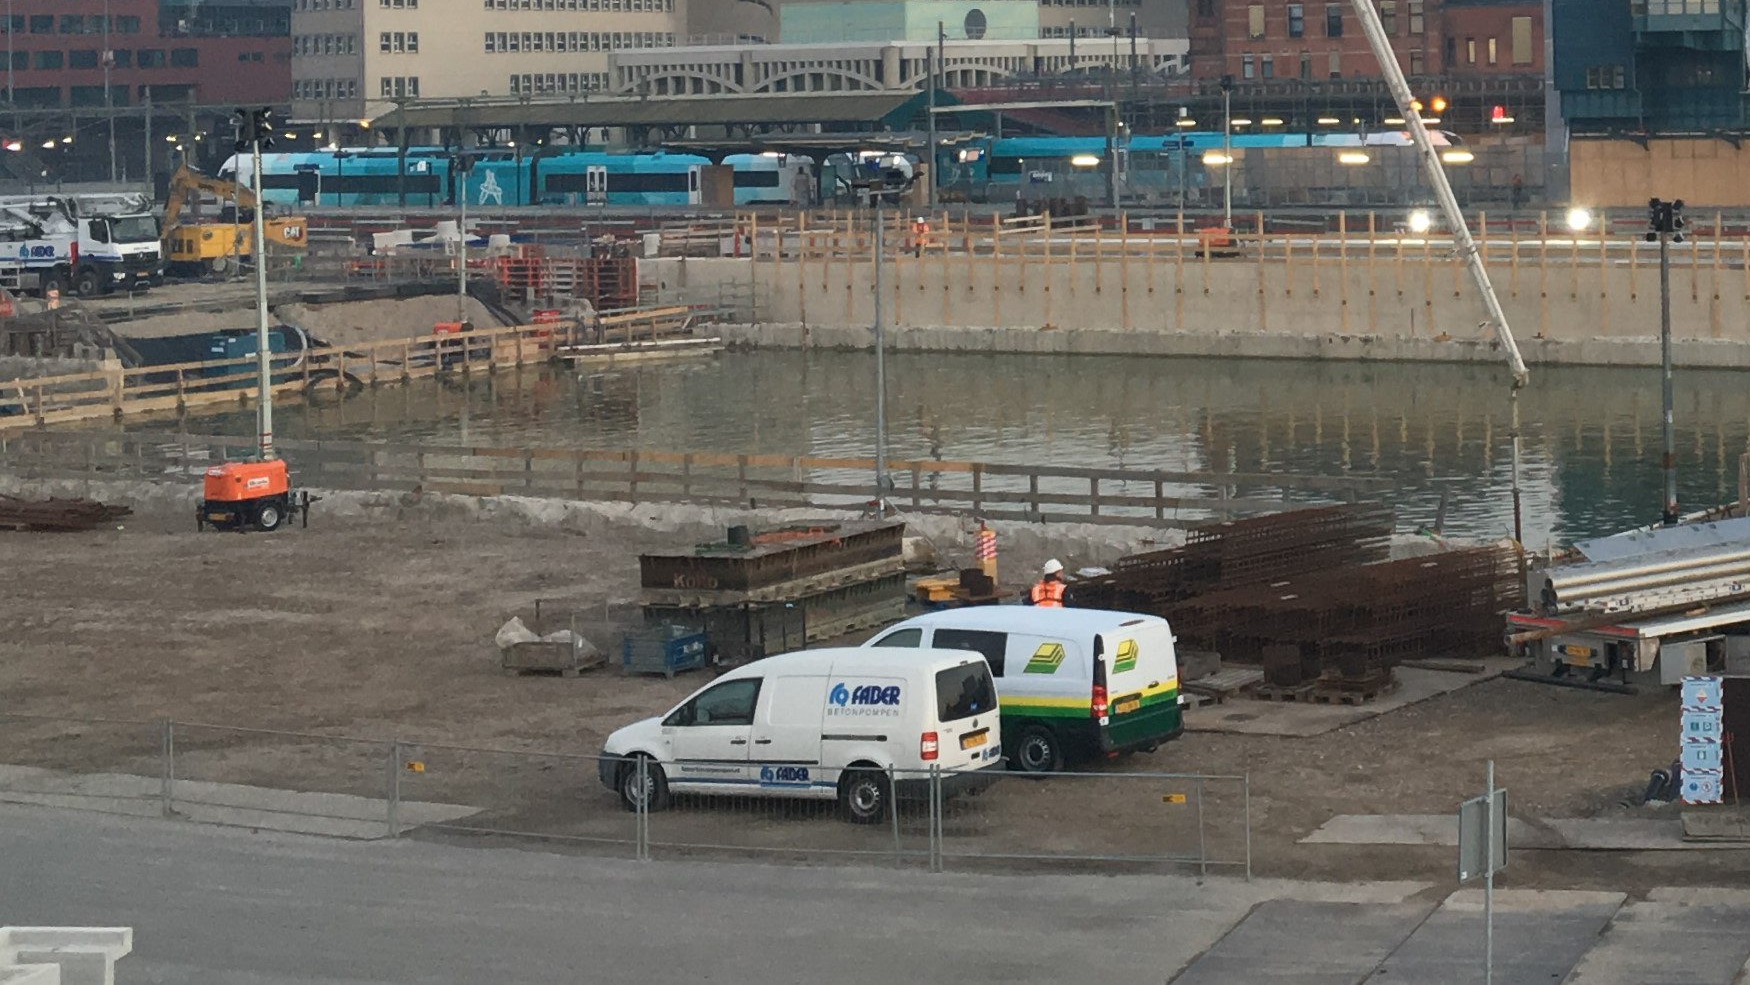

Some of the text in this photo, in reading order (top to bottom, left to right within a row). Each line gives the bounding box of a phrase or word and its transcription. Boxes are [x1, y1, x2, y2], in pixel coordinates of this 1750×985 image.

[284, 227, 300, 239] CAT
[851, 685, 901, 706] FADER
[827, 707, 900, 717] BETONPOMPEN
[776, 767, 809, 781] FADER
